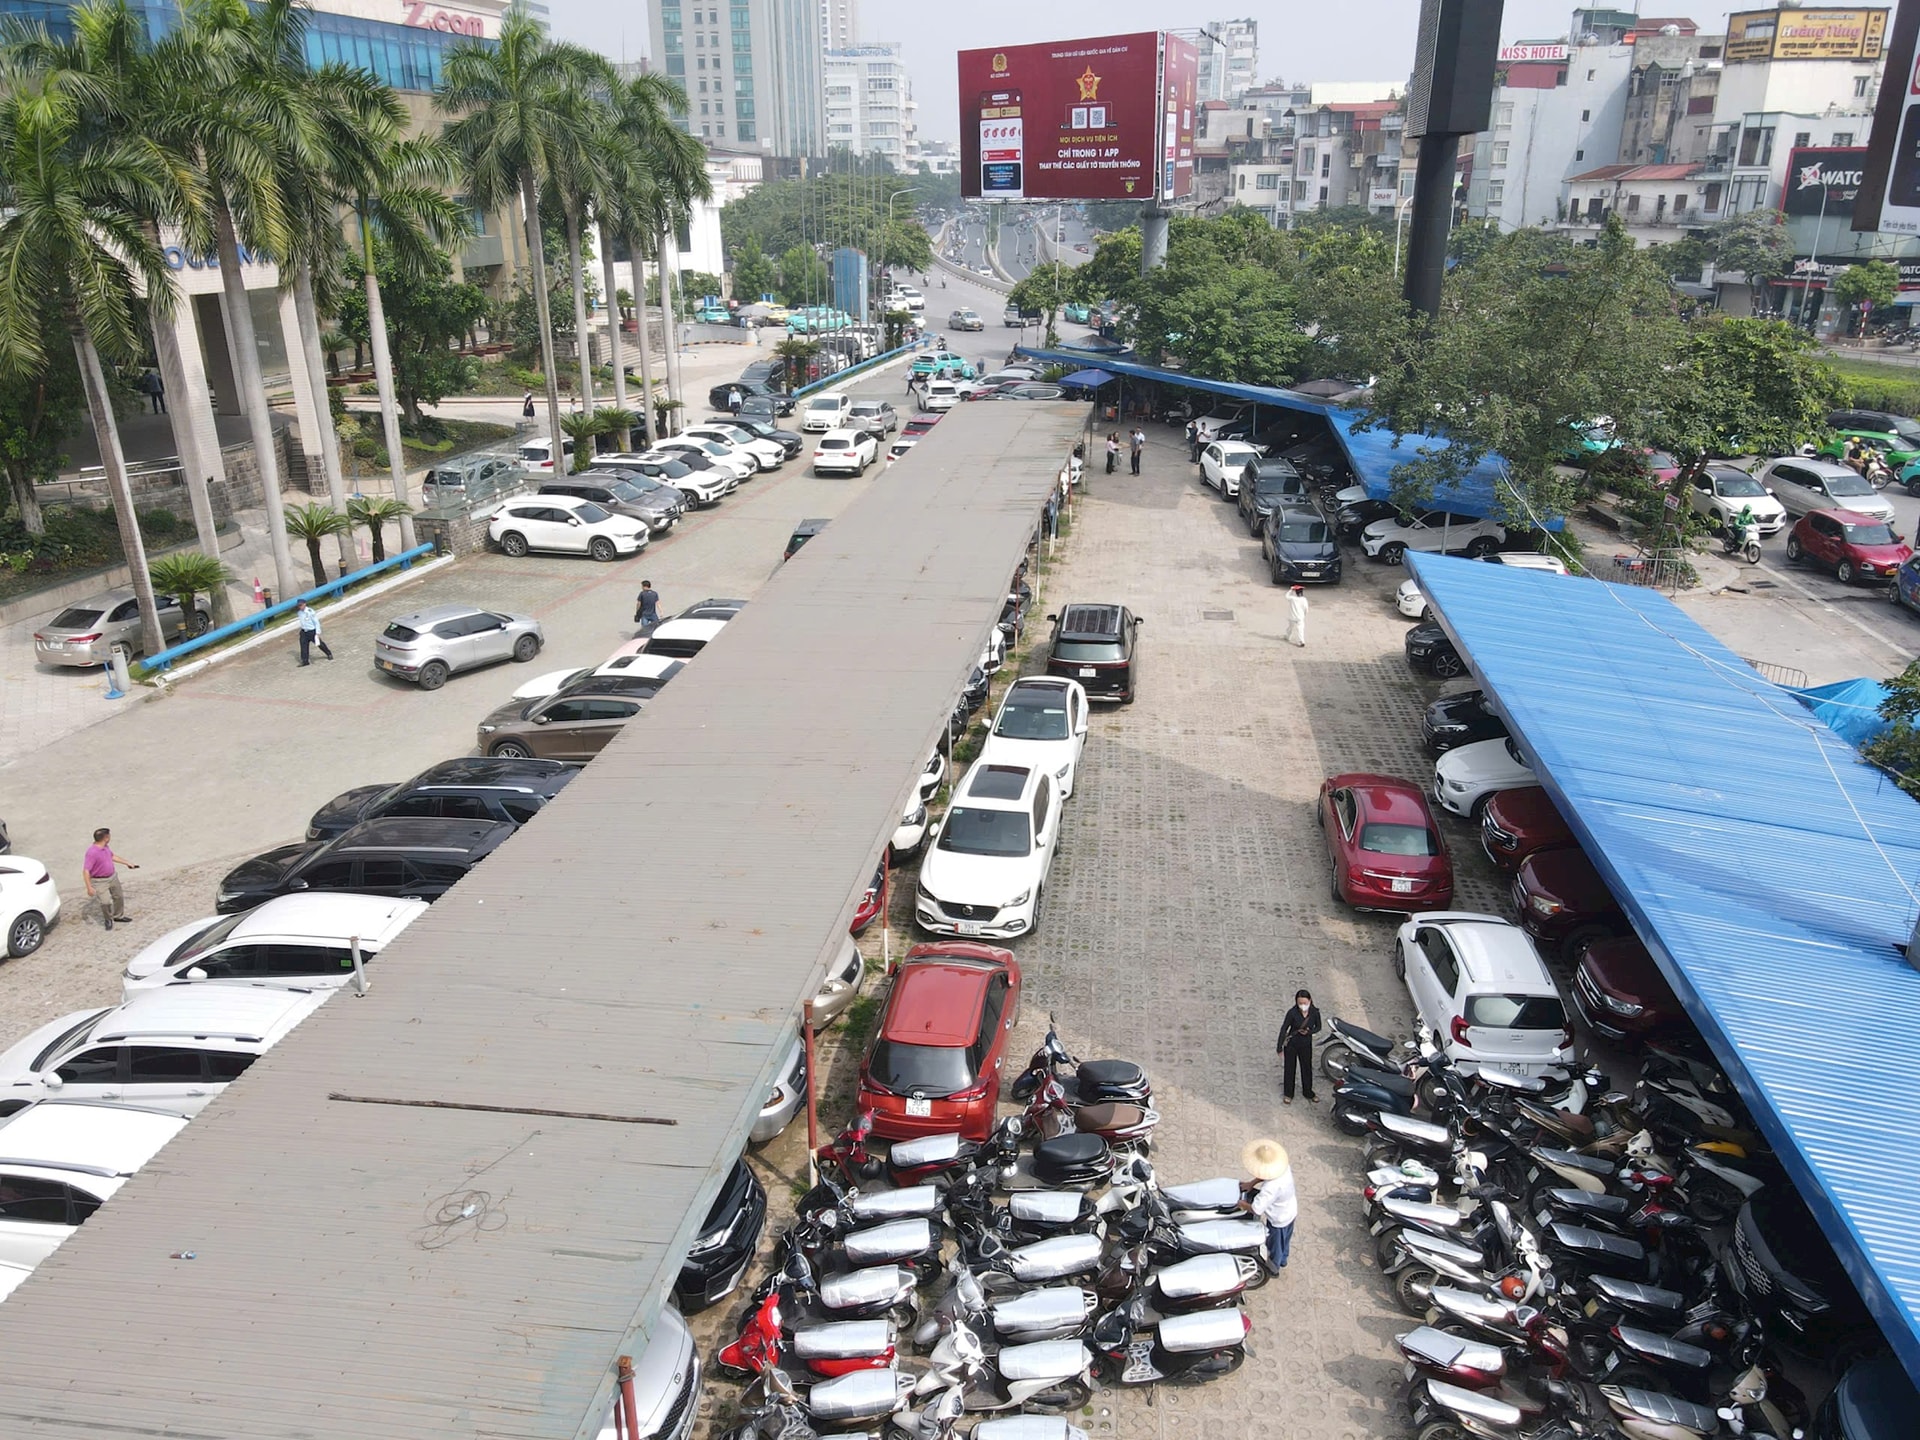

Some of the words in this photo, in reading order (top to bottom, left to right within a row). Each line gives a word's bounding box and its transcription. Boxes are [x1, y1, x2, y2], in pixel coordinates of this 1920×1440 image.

[1501, 47, 1528, 59] KISS
[1531, 46, 1564, 58] HOTEL
[1060, 136, 1070, 144] MỌI
[1072, 136, 1085, 144] DỊCH
[1094, 134, 1106, 142] TIỆN
[1058, 148, 1071, 158] CHỈ
[1072, 148, 1096, 158] TRONG
[1098, 148, 1102, 157] 1
[1104, 148, 1119, 157] APP
[1062, 160, 1075, 169] CÁC
[1076, 160, 1089, 169] GIẤY
[1120, 158, 1140, 168] THỐNG
